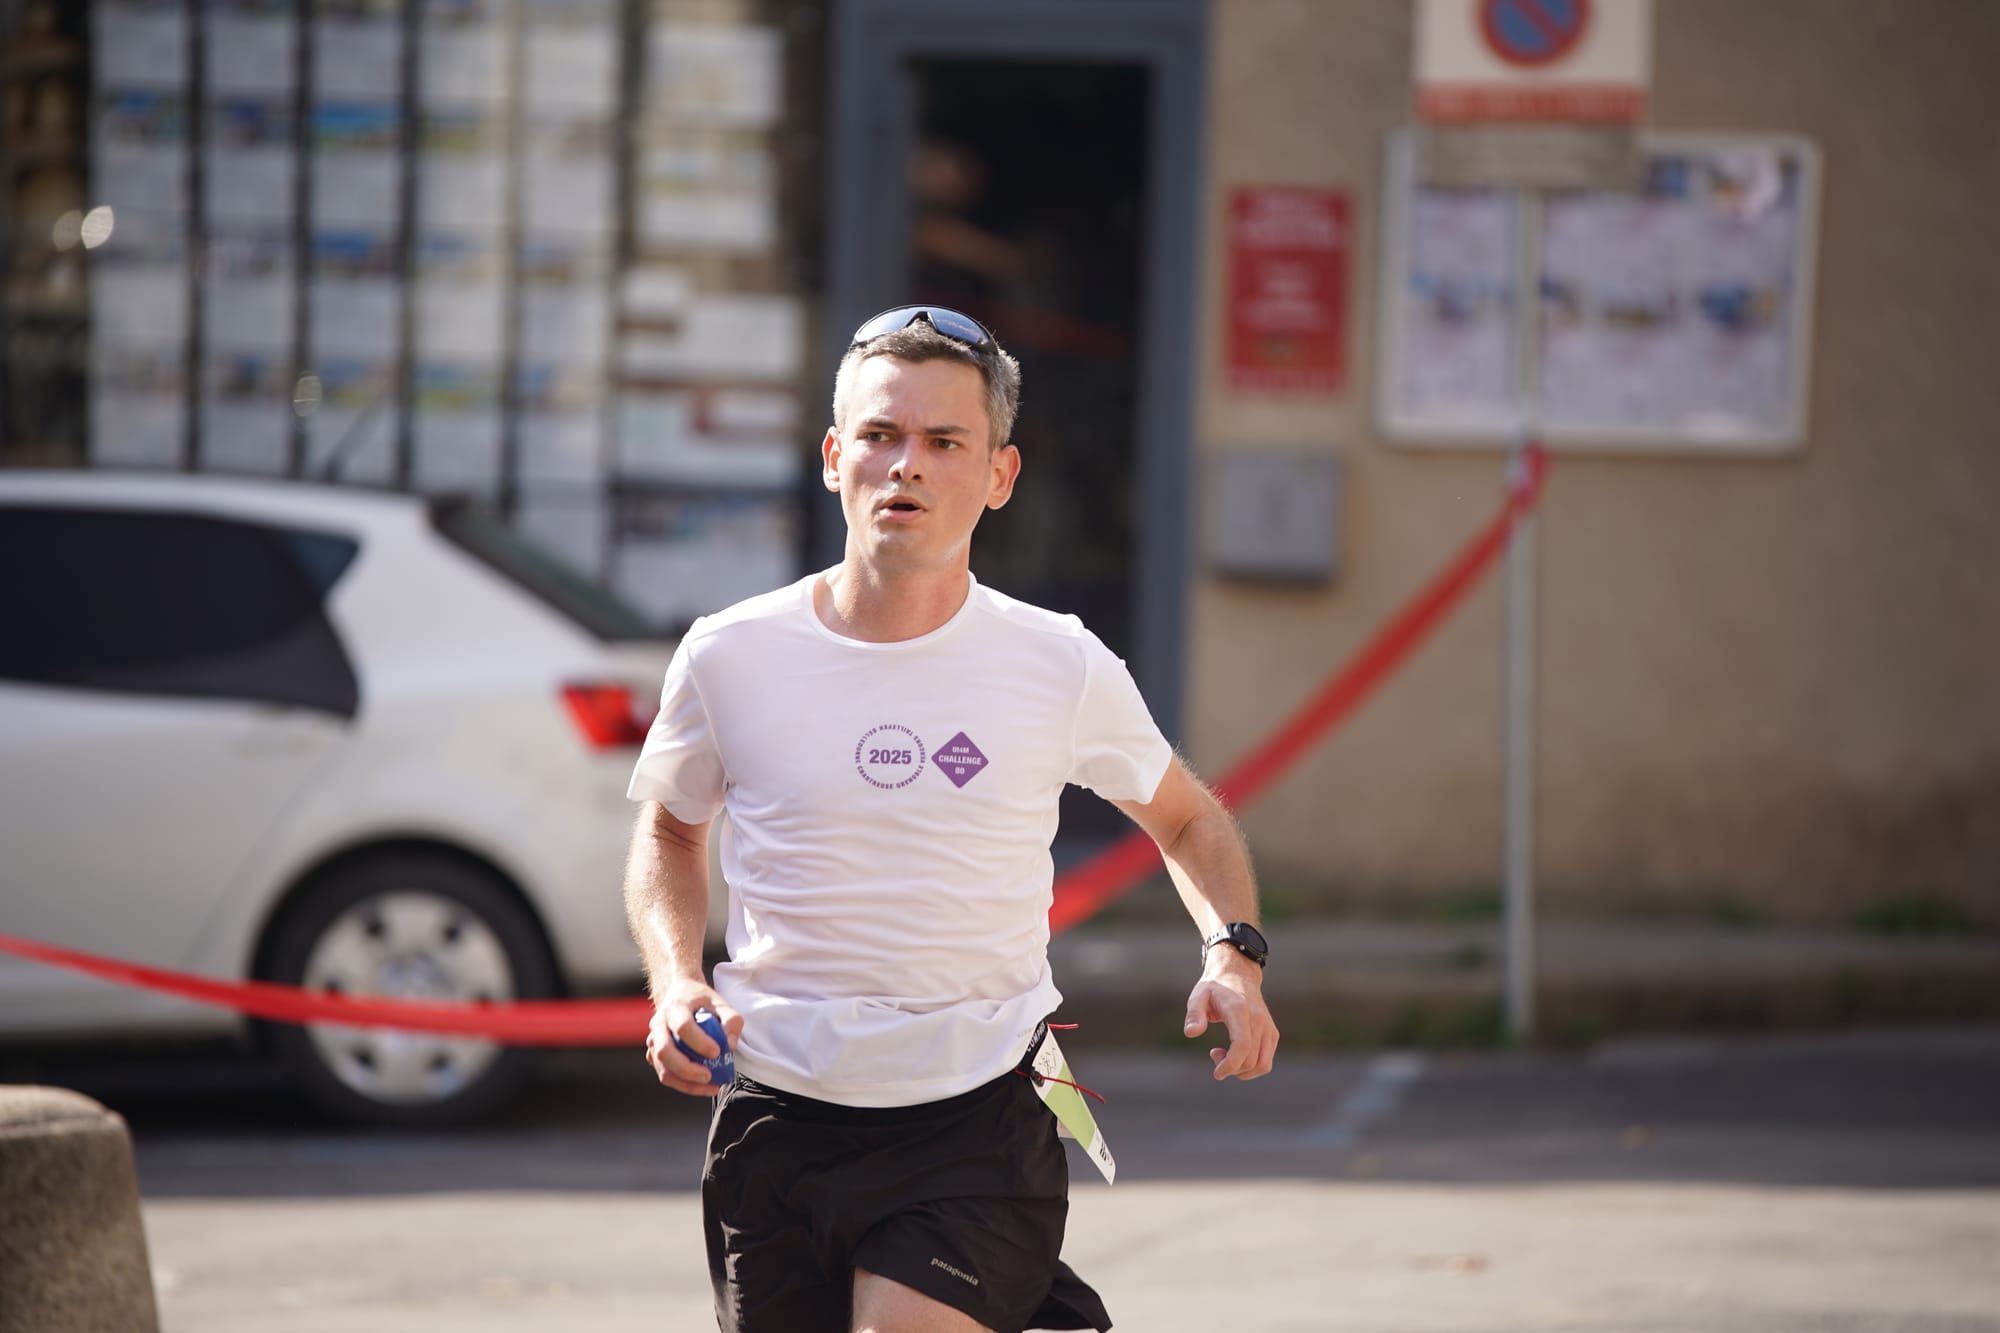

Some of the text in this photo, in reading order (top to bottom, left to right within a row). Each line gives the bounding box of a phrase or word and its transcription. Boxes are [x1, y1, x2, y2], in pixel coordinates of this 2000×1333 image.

[869, 749, 912, 765] 2025
[938, 754, 982, 766] CHALLENGE
[930, 1257, 979, 1287] patagonia
